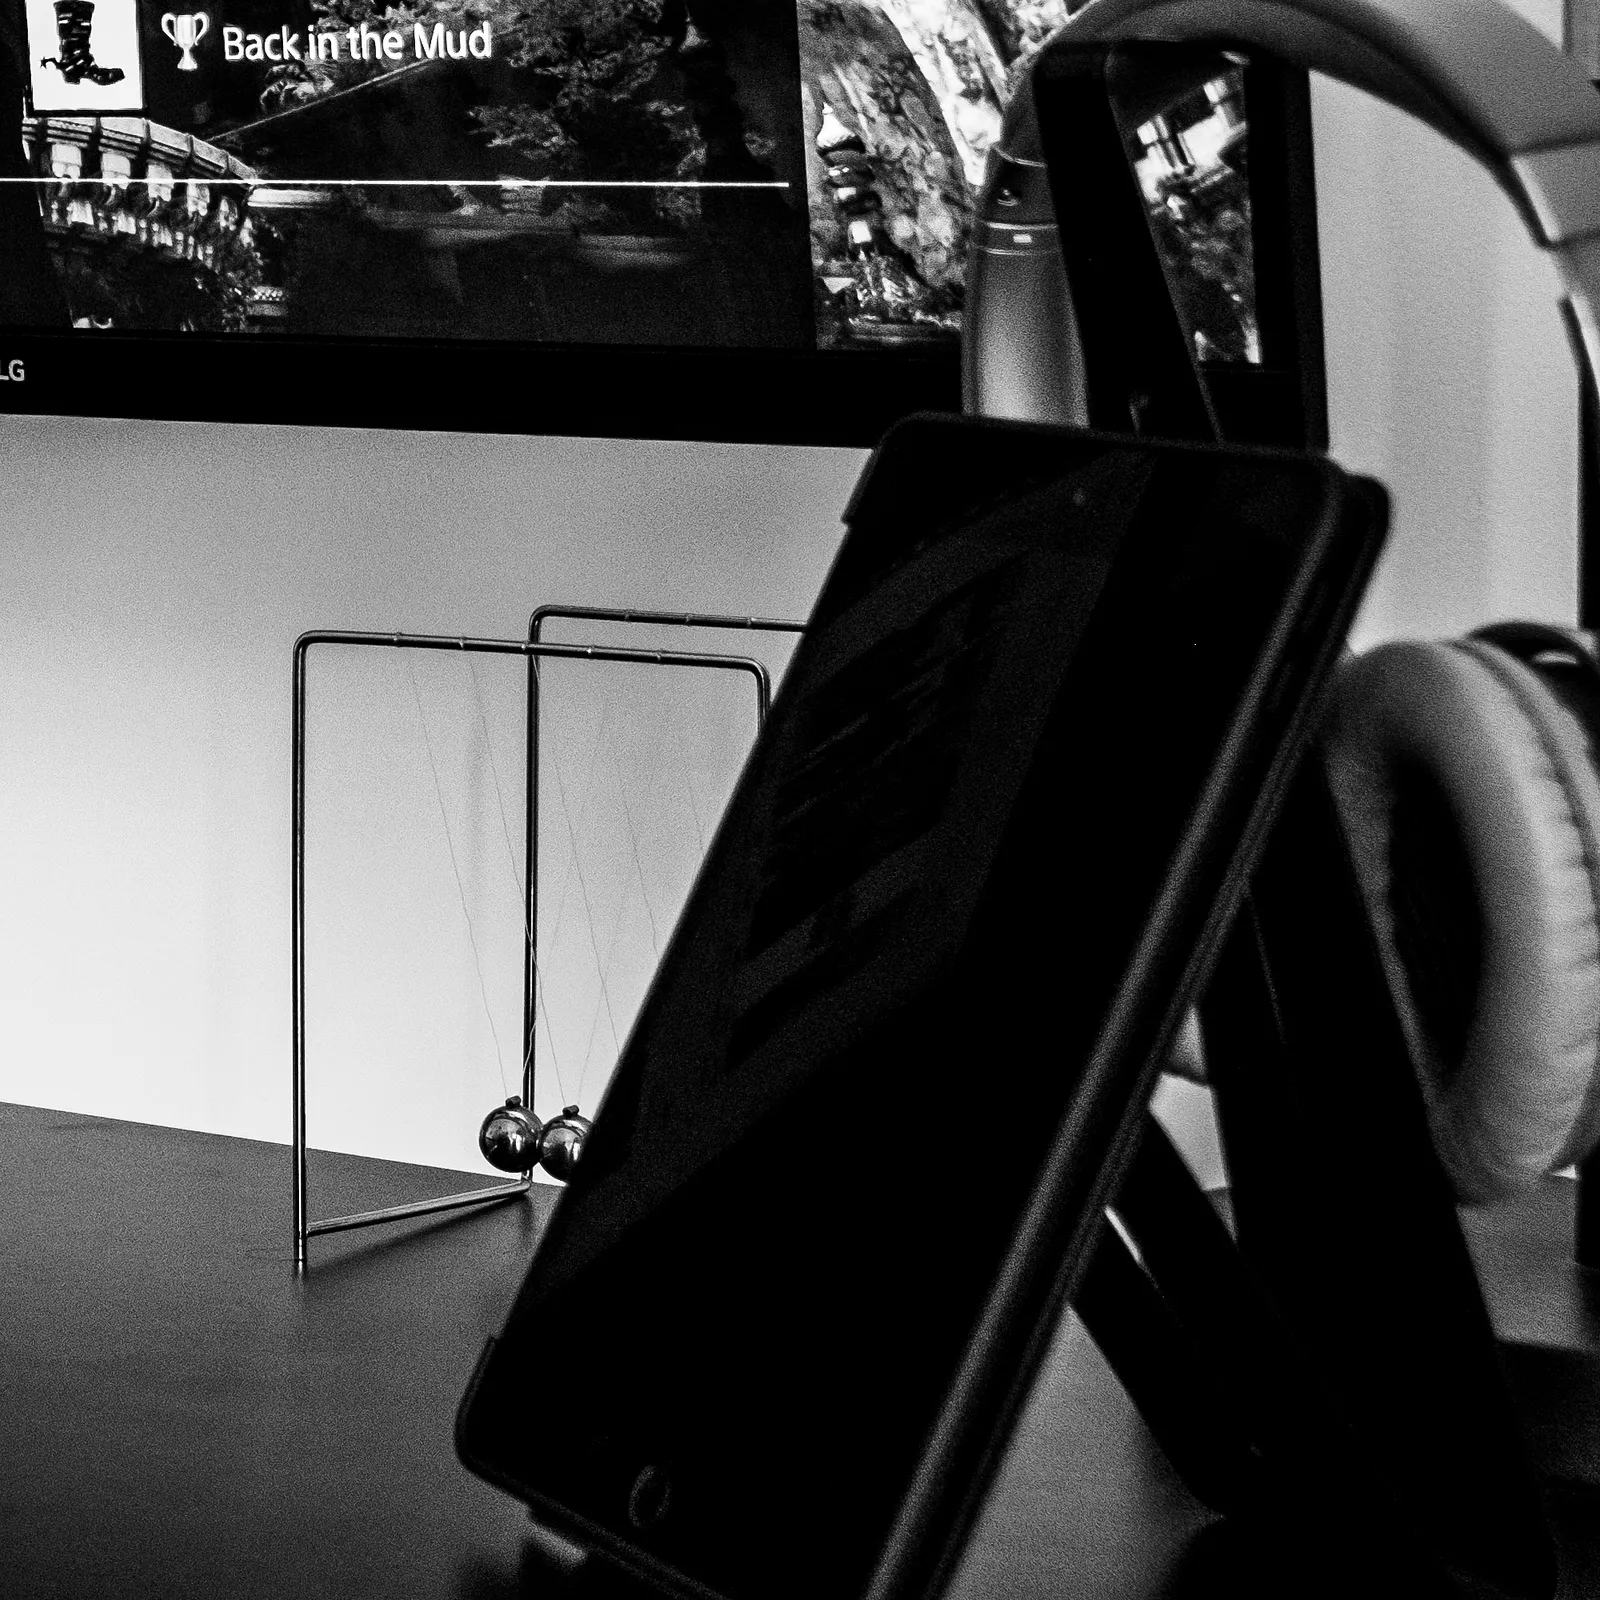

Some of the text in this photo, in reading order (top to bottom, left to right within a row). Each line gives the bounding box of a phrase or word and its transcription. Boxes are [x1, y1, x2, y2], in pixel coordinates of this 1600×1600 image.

[223, 22, 492, 62] Back in the Mud
